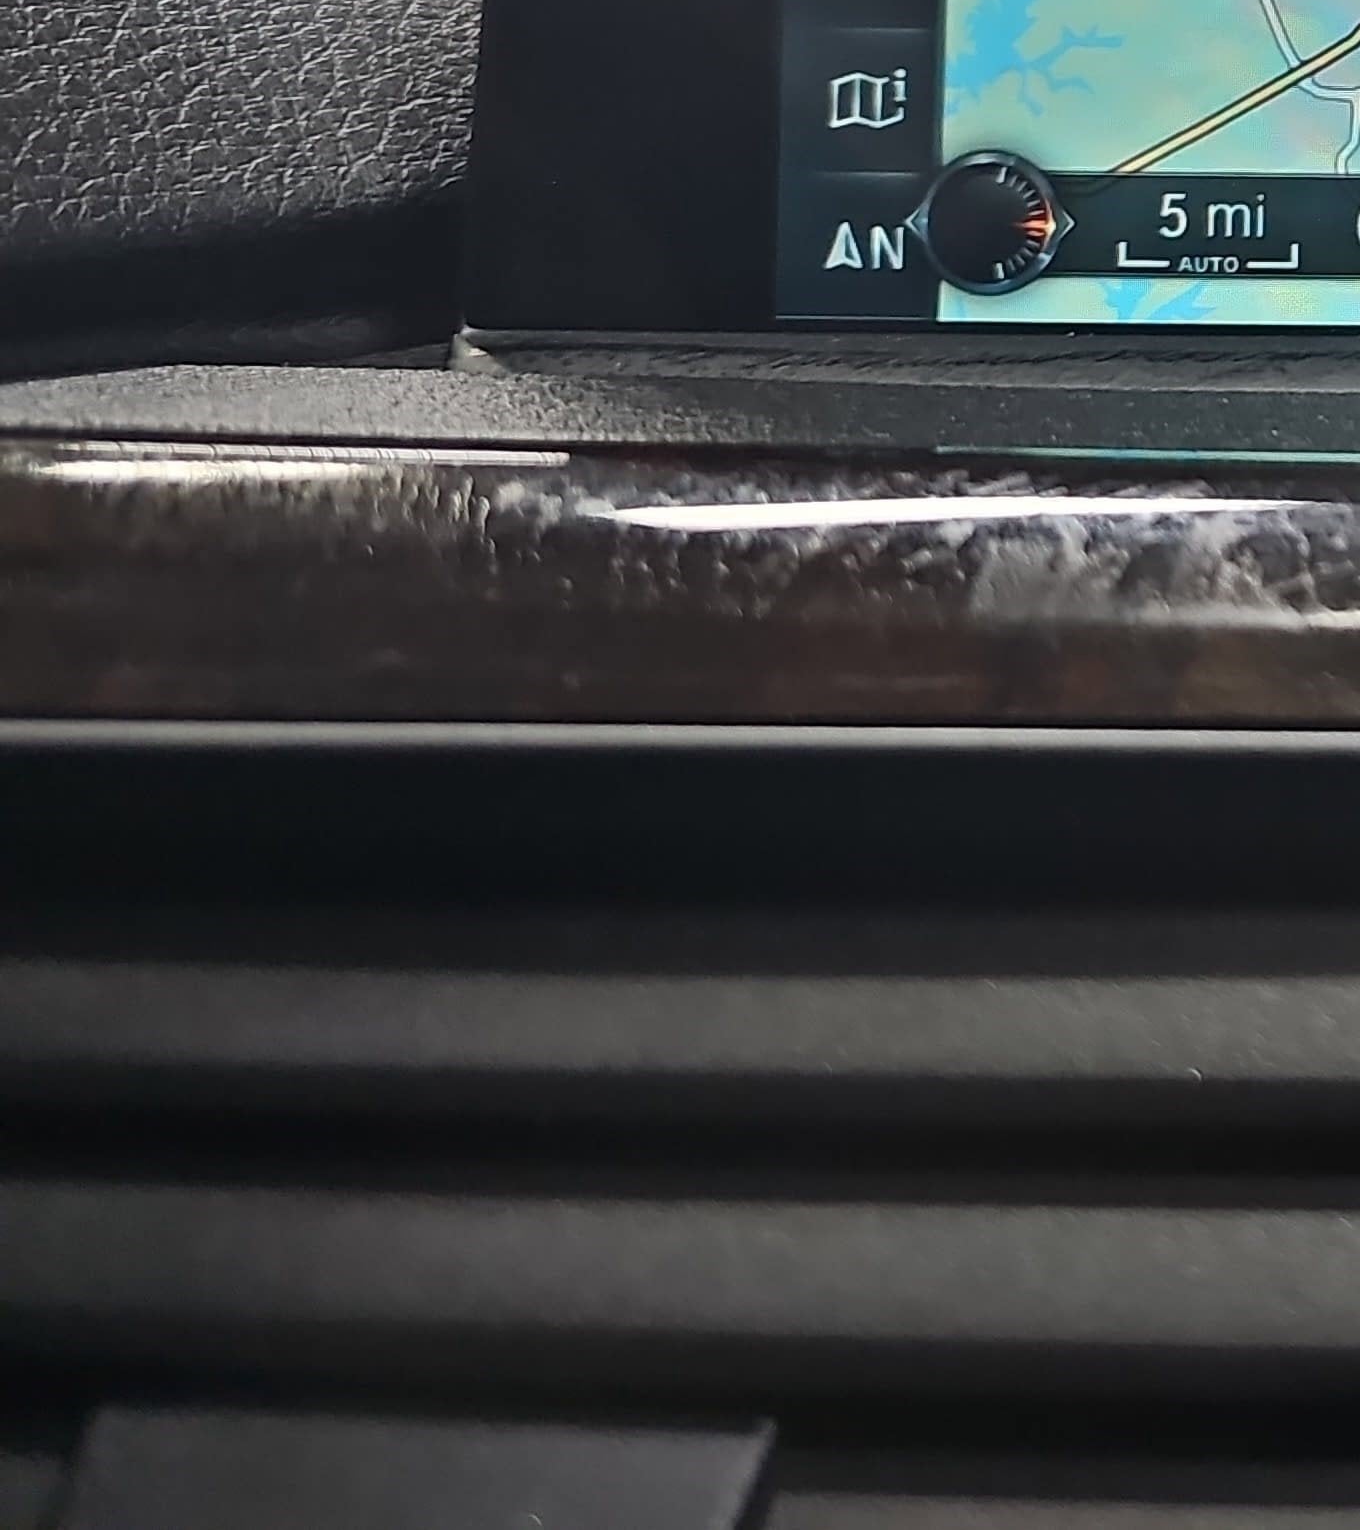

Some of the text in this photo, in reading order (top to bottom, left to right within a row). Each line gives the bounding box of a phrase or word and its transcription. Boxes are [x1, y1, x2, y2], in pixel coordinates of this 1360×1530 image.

[1160, 193, 1266, 238] 5 mi
[1178, 256, 1238, 273] AUTO
